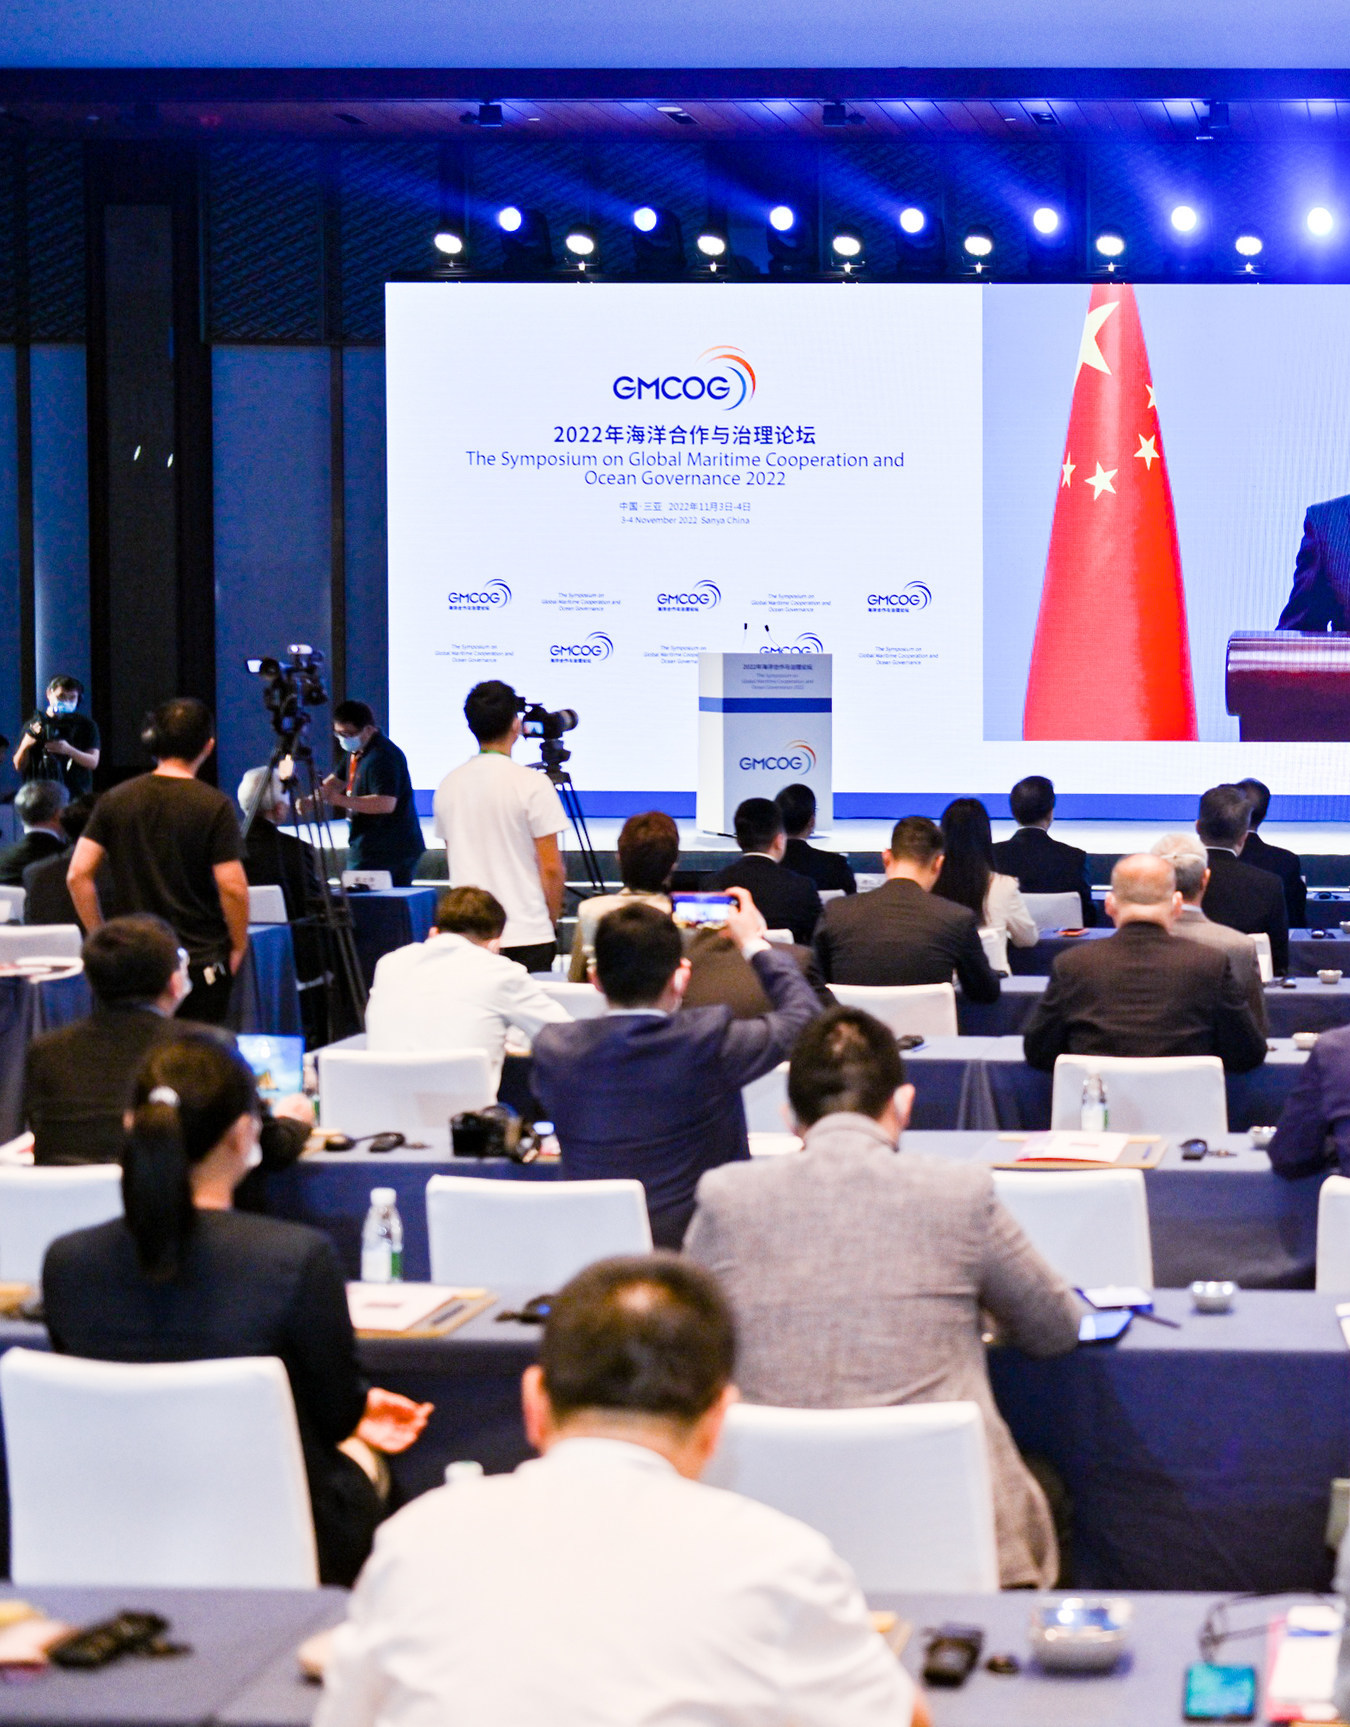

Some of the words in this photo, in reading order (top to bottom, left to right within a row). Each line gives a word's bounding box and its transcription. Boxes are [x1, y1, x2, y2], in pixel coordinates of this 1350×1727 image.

[613, 376, 730, 400] GMCOG
[554, 424, 816, 444] 2022年海洋合作与治理论坛
[466, 451, 496, 466] The
[501, 451, 598, 470] Symposium
[602, 454, 624, 466] on
[628, 452, 682, 466] Global
[687, 452, 761, 467] Maritime
[766, 452, 868, 470] Cooperation
[874, 452, 904, 467] and
[584, 470, 636, 485] Ocean
[642, 470, 740, 485] Governance
[746, 472, 786, 486] 2022
[668, 502, 751, 512] 2022年11月3日-4日
[700, 516, 725, 526] Sanya
[448, 592, 500, 603] GMCOG
[658, 593, 709, 604] GMCOG
[868, 594, 920, 605] GMCOG
[550, 645, 602, 656] GMCOG
[740, 757, 802, 770] GMCOG
